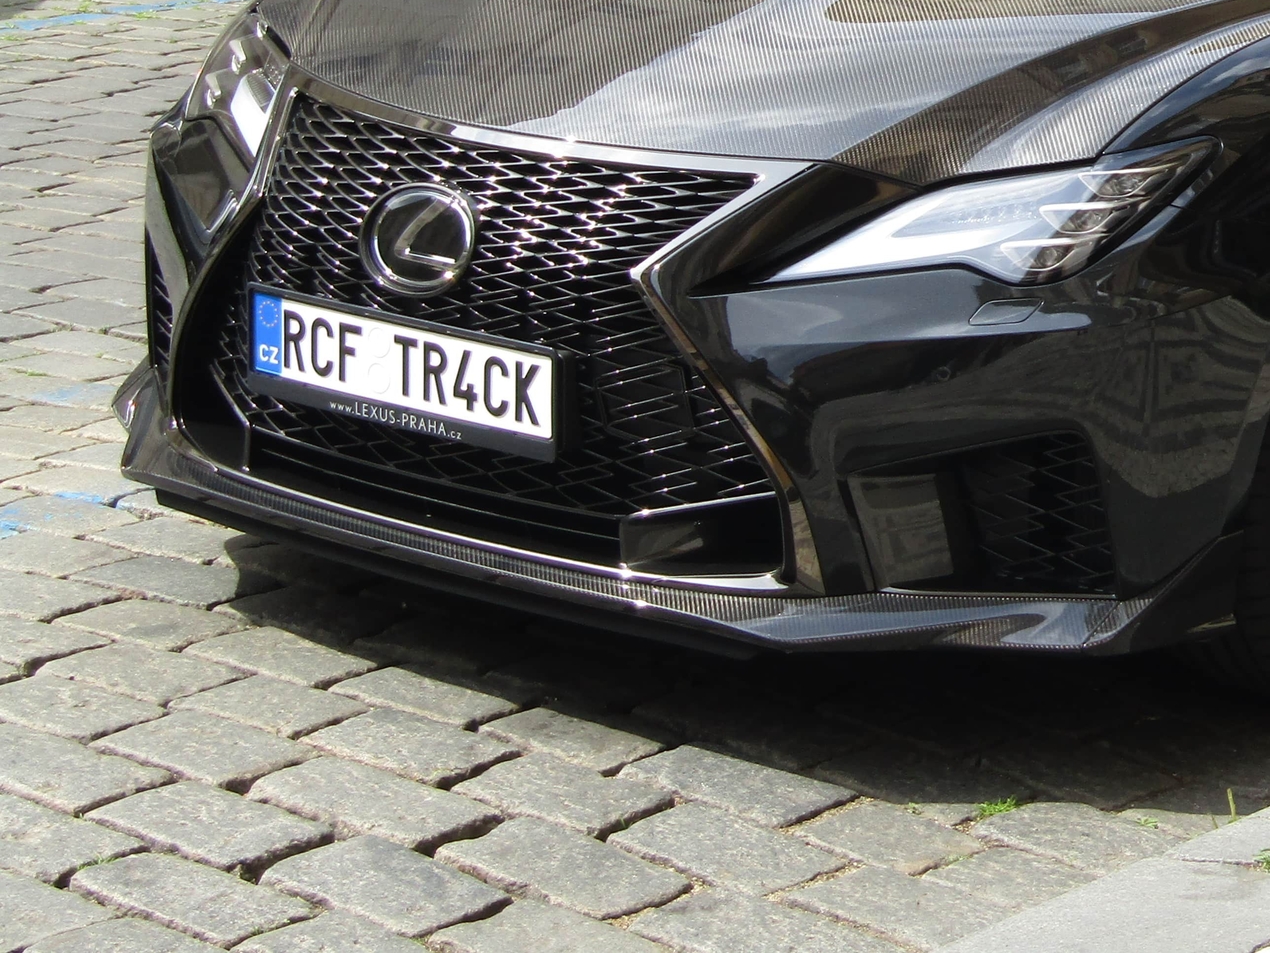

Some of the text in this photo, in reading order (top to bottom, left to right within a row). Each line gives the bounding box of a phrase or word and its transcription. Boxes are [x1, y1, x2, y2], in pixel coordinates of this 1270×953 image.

[259, 343, 279, 365] CZ
[283, 308, 542, 428] RCF TR4CK
[329, 401, 463, 440] www.LEXUS-PRAHA.cz
